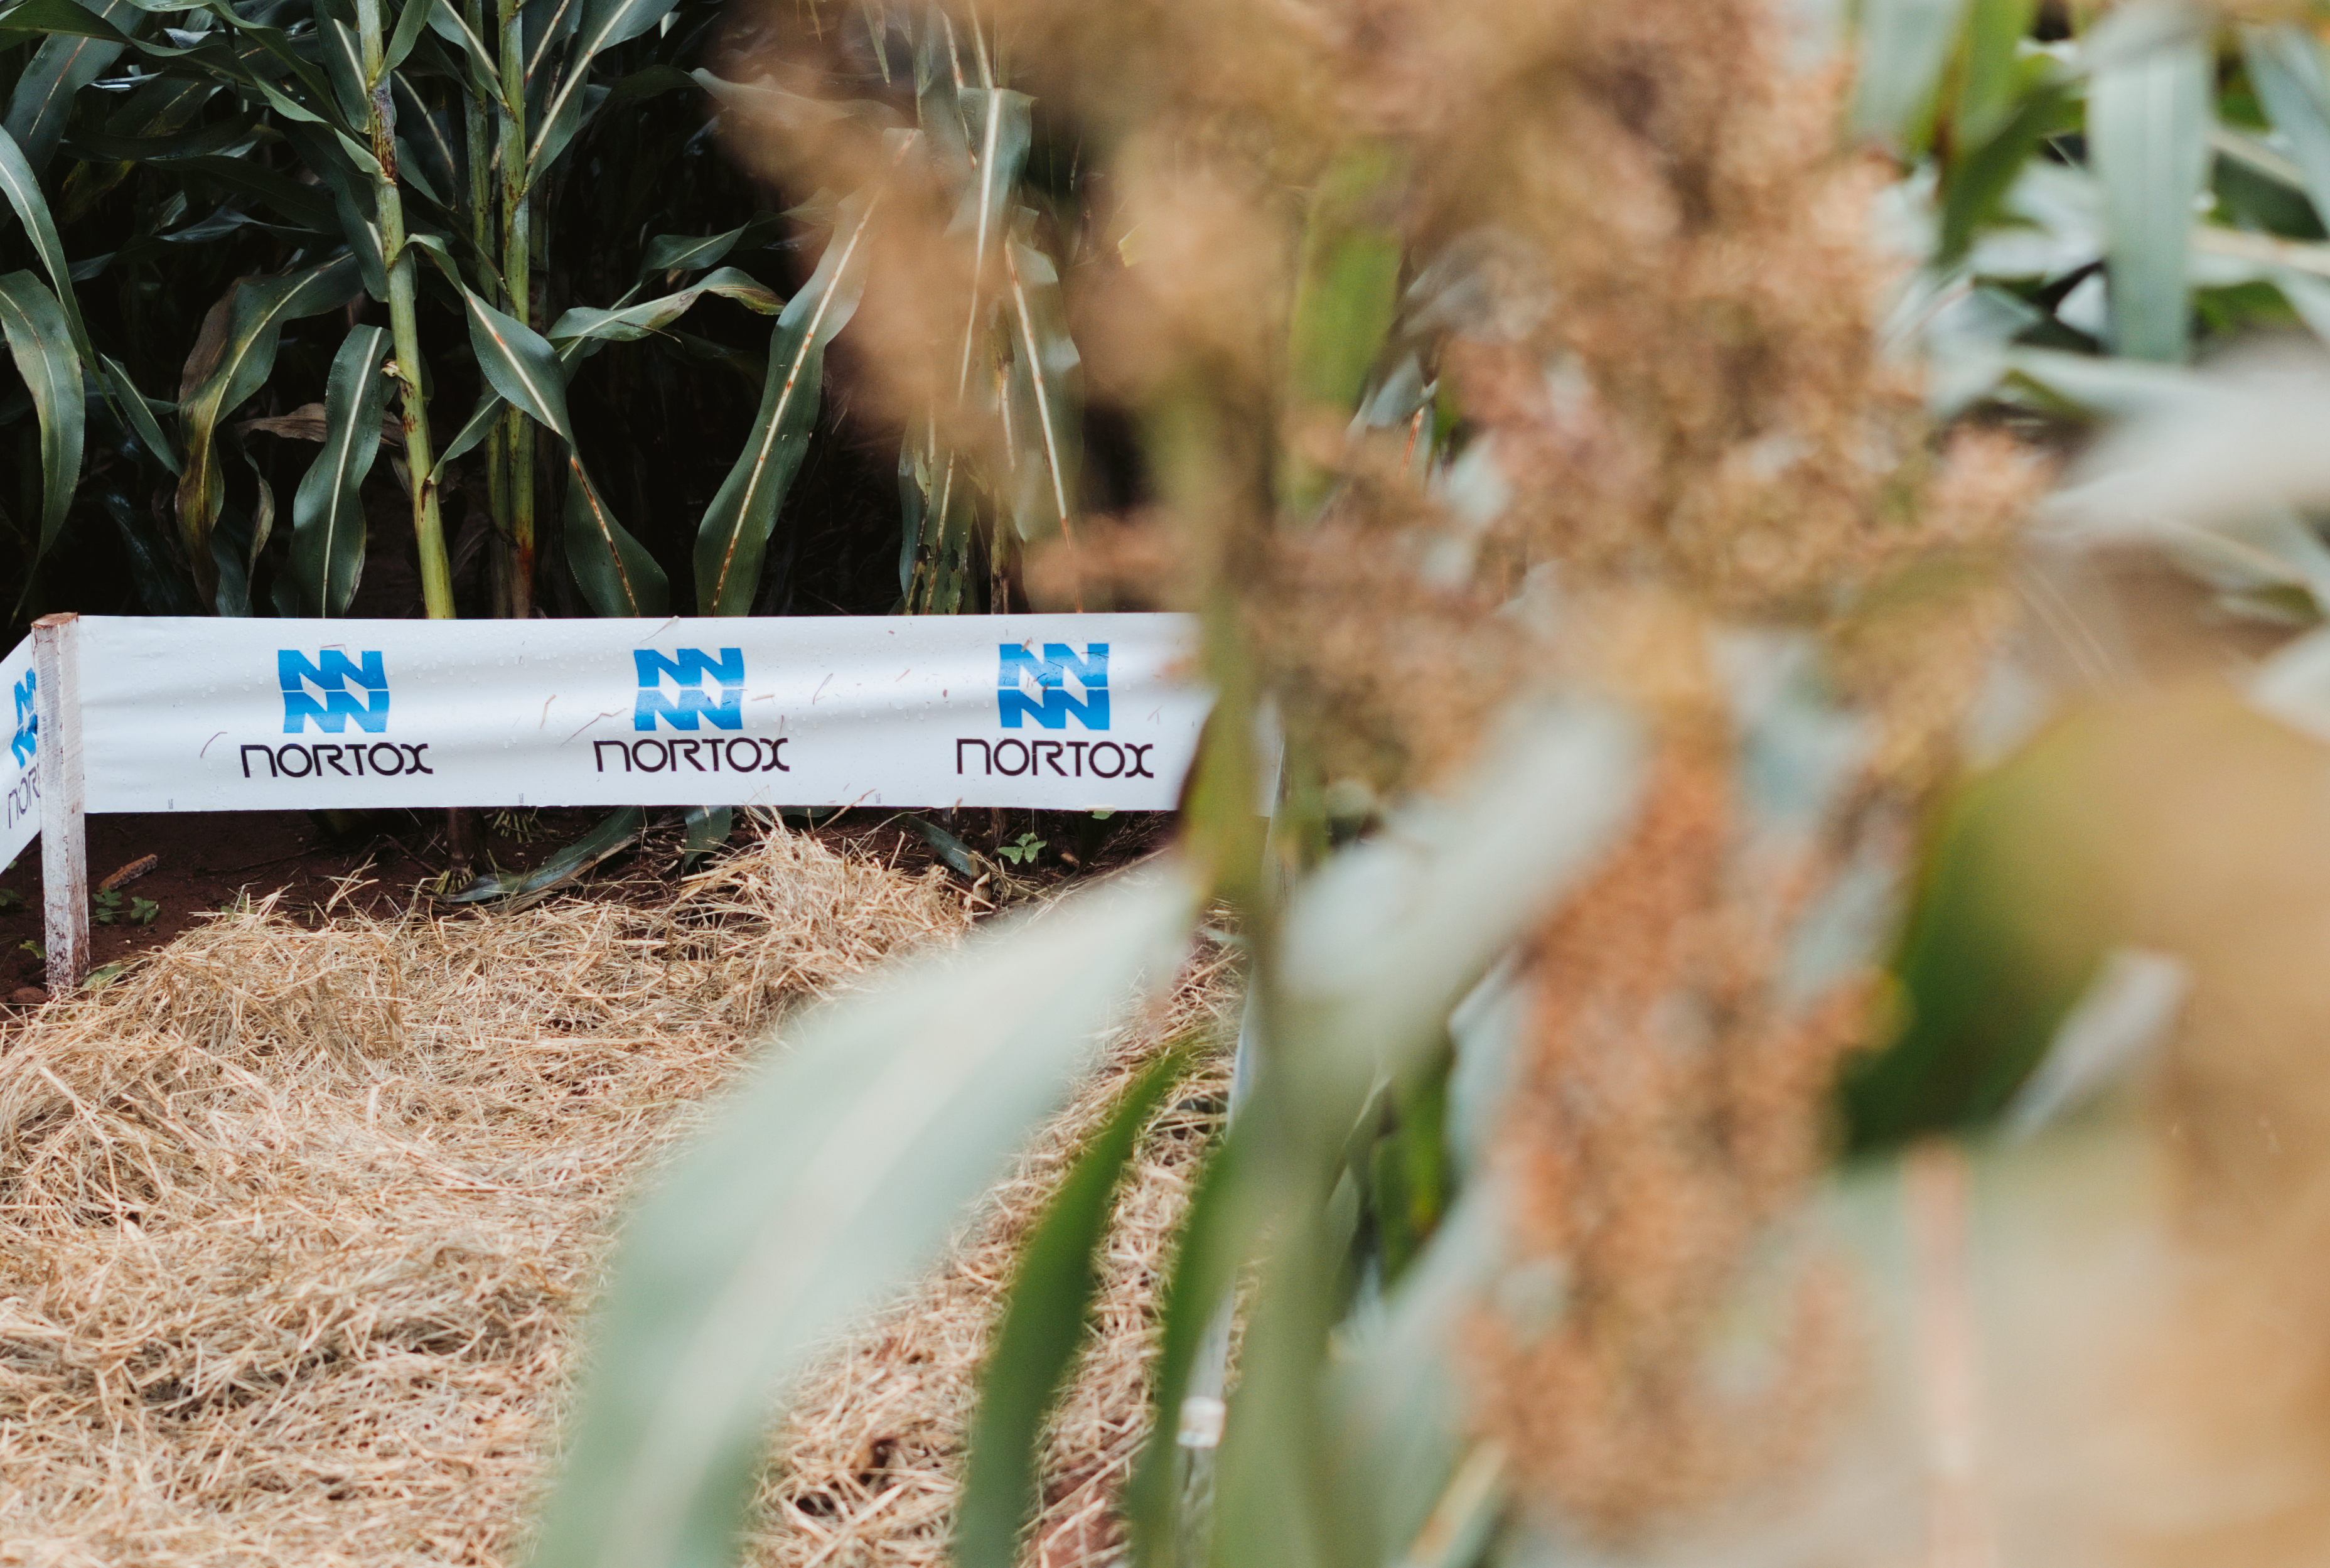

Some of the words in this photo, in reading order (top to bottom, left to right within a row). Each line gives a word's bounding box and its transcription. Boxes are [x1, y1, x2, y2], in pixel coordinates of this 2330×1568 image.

[240, 743, 433, 778] NORTOX
[593, 737, 790, 773] NORTOX
[957, 738, 1154, 778] NORTOX
[8, 765, 40, 829] NOR
